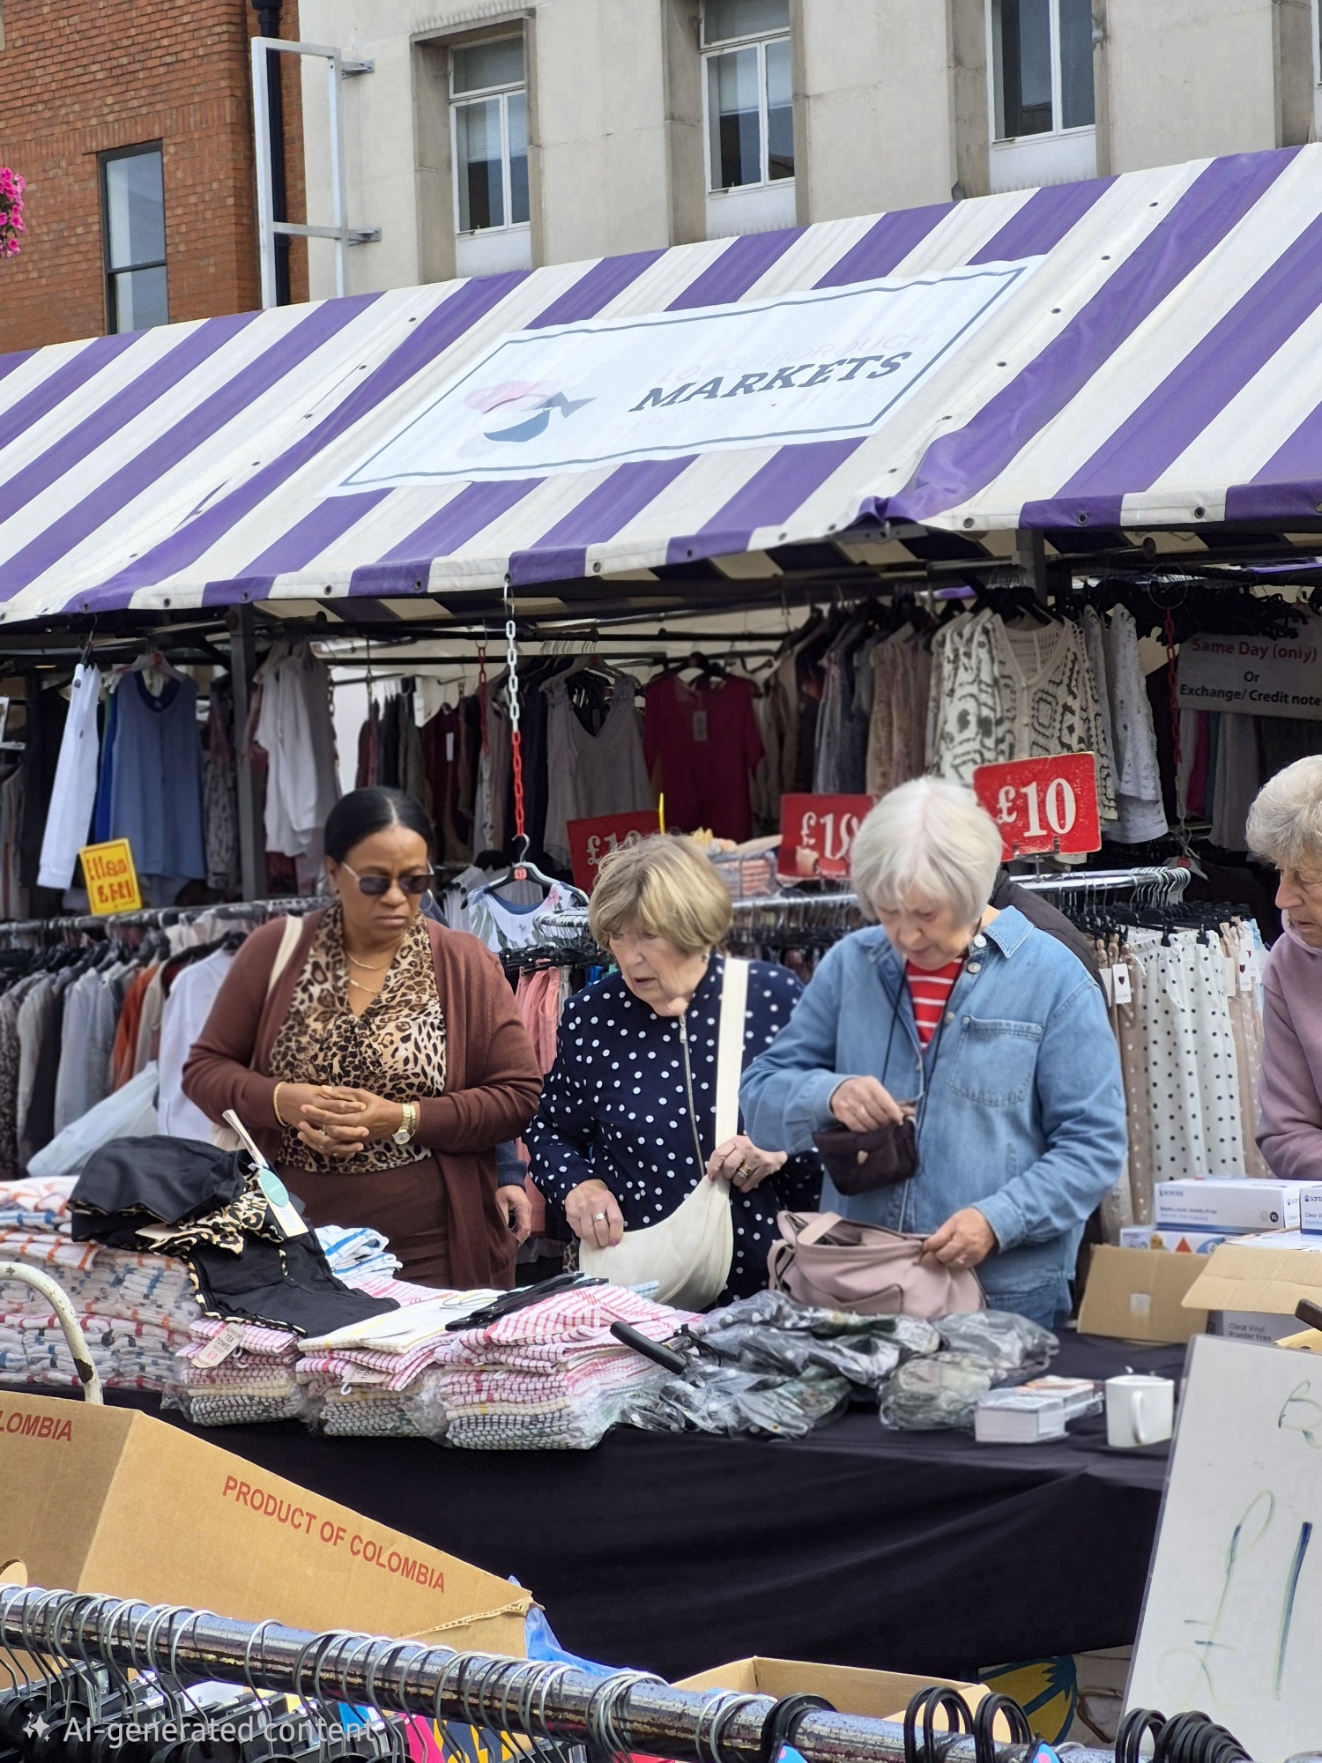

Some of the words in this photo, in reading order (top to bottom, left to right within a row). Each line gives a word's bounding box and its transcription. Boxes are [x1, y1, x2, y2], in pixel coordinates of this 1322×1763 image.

[627, 351, 913, 413] MARKETS
[1192, 638, 1235, 654] Same
[1238, 641, 1269, 659] Day
[1243, 671, 1261, 683] Or
[1180, 684, 1247, 702] Exchange/
[1249, 689, 1289, 704] Credit
[996, 777, 1077, 838] £10
[1229, 1322, 1247, 1331] Clear
[1229, 1331, 1254, 1340] Powder
[1256, 1334, 1272, 1342] Free
[222, 1475, 317, 1534] PRODUCT
[319, 1520, 347, 1547] OF
[350, 1534, 445, 1594] COLOMBIA
